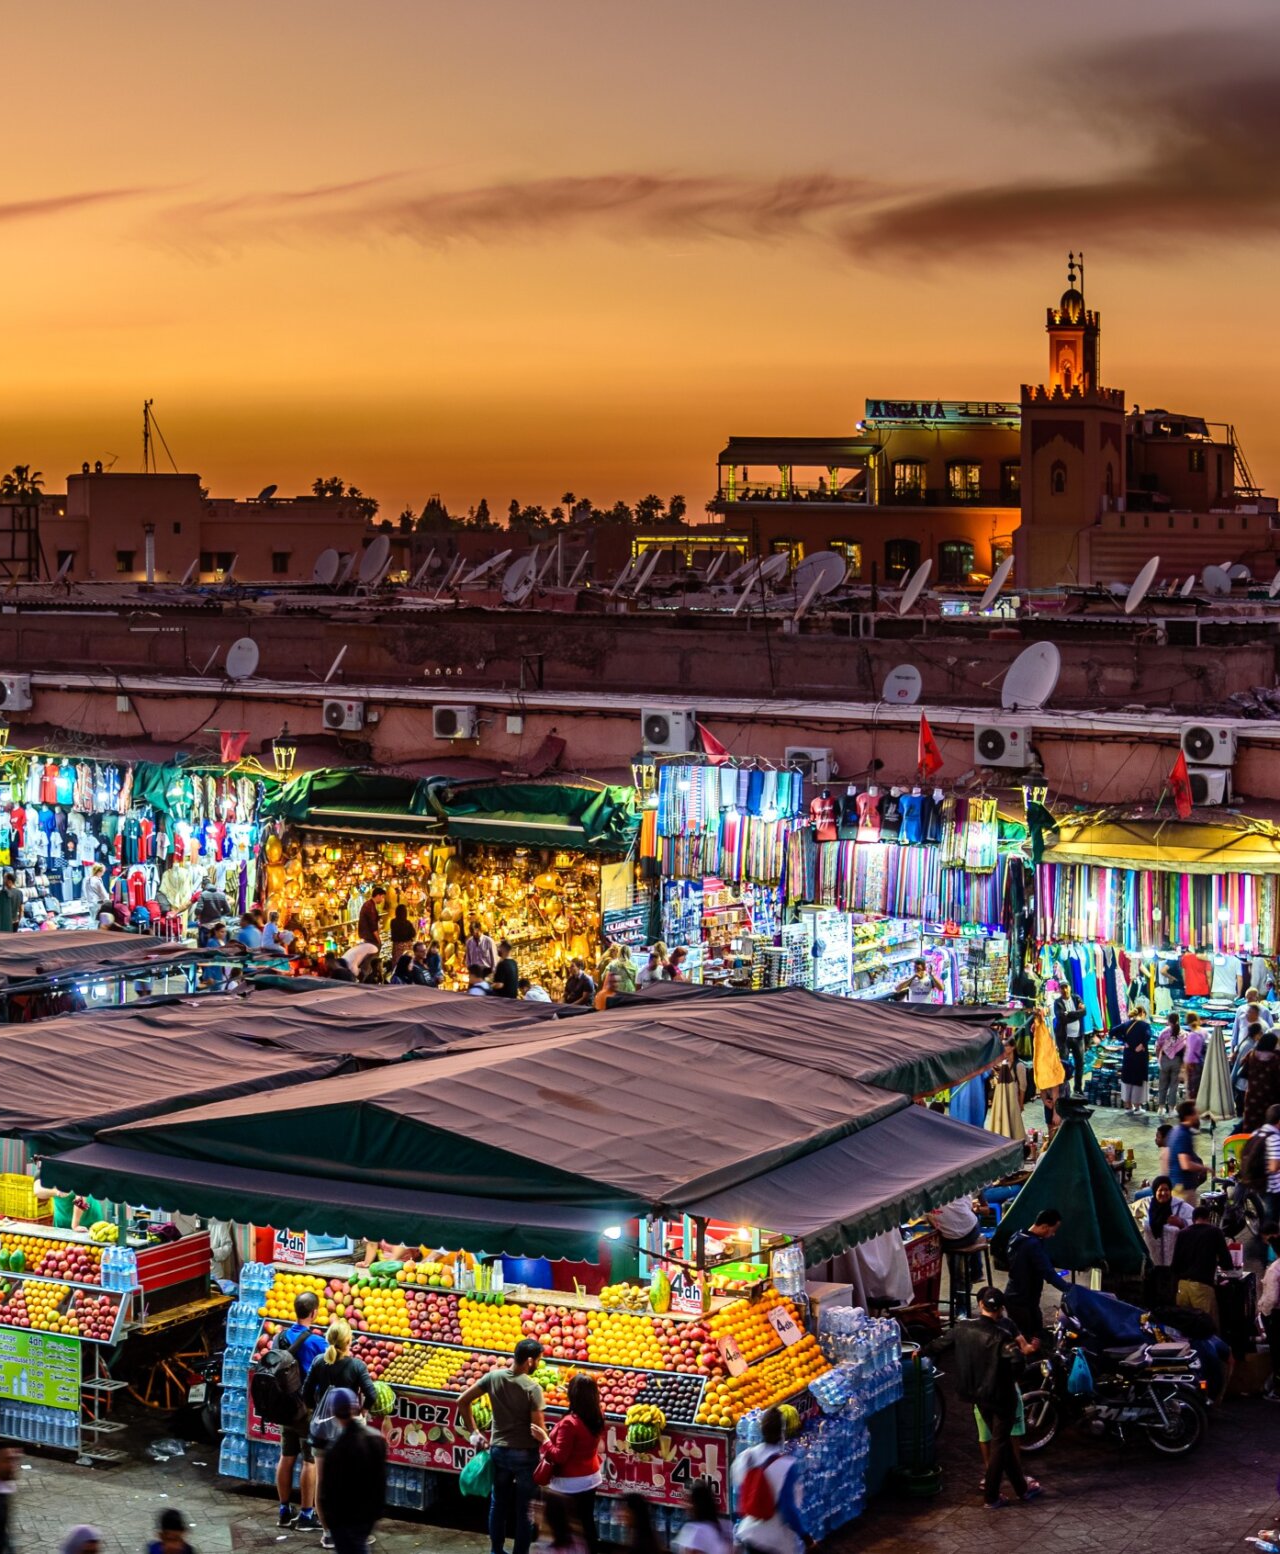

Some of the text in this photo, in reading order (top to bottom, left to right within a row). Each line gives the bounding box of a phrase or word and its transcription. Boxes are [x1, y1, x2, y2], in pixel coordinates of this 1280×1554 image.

[277, 1229, 304, 1251] 4dh
[671, 1272, 700, 1300] 4dh
[776, 1319, 793, 1332] 4dh
